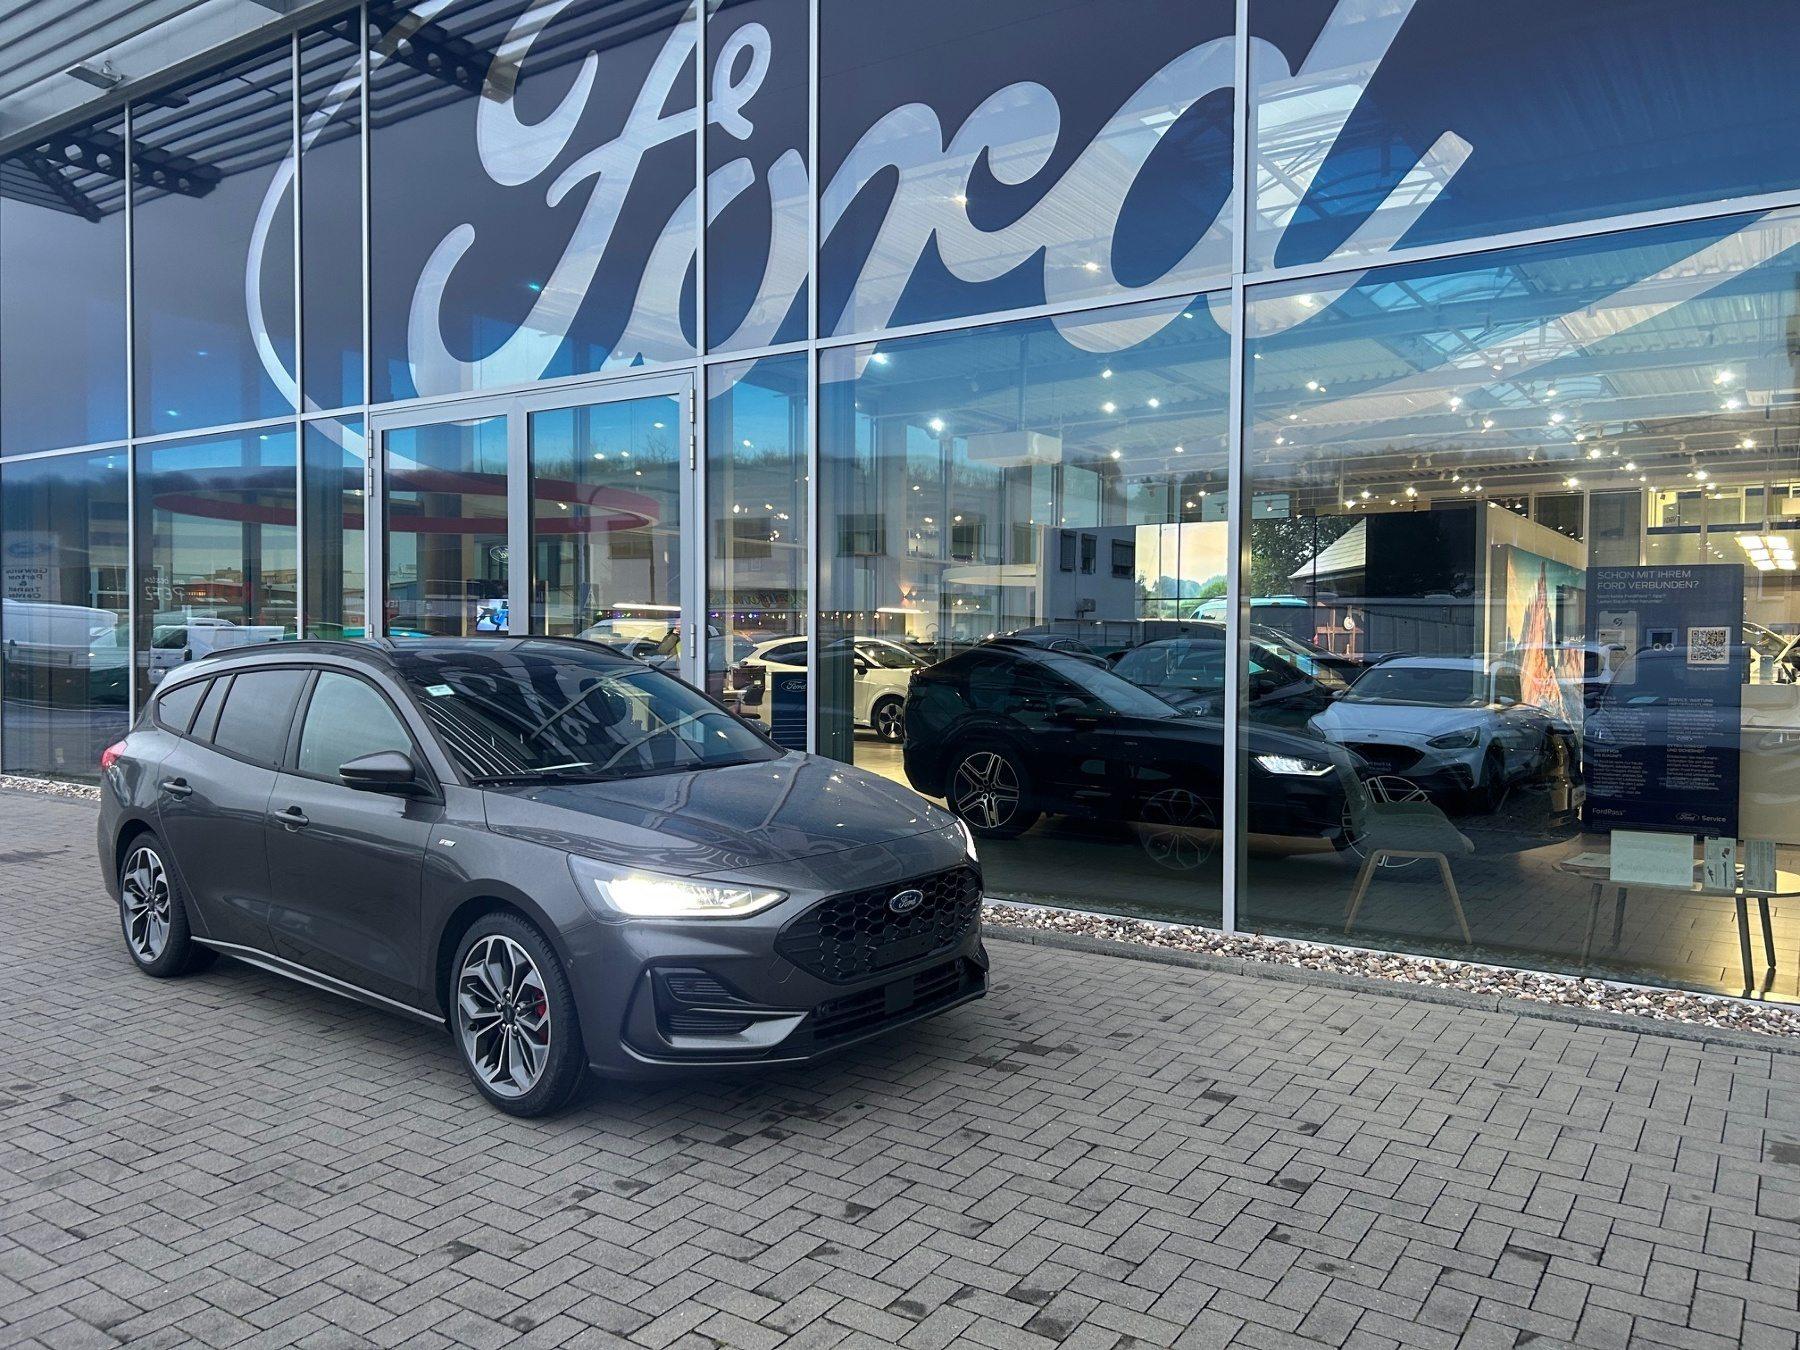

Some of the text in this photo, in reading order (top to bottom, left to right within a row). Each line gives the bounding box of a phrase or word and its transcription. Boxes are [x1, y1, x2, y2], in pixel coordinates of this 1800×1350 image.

[406, 0, 1474, 422] Ford
[1597, 570, 1692, 579] SCHON MIT IHREM
[1597, 580, 1700, 590] FORD VERBUNDEN?
[786, 680, 807, 690] Ford
[1701, 815, 1727, 823] Service
